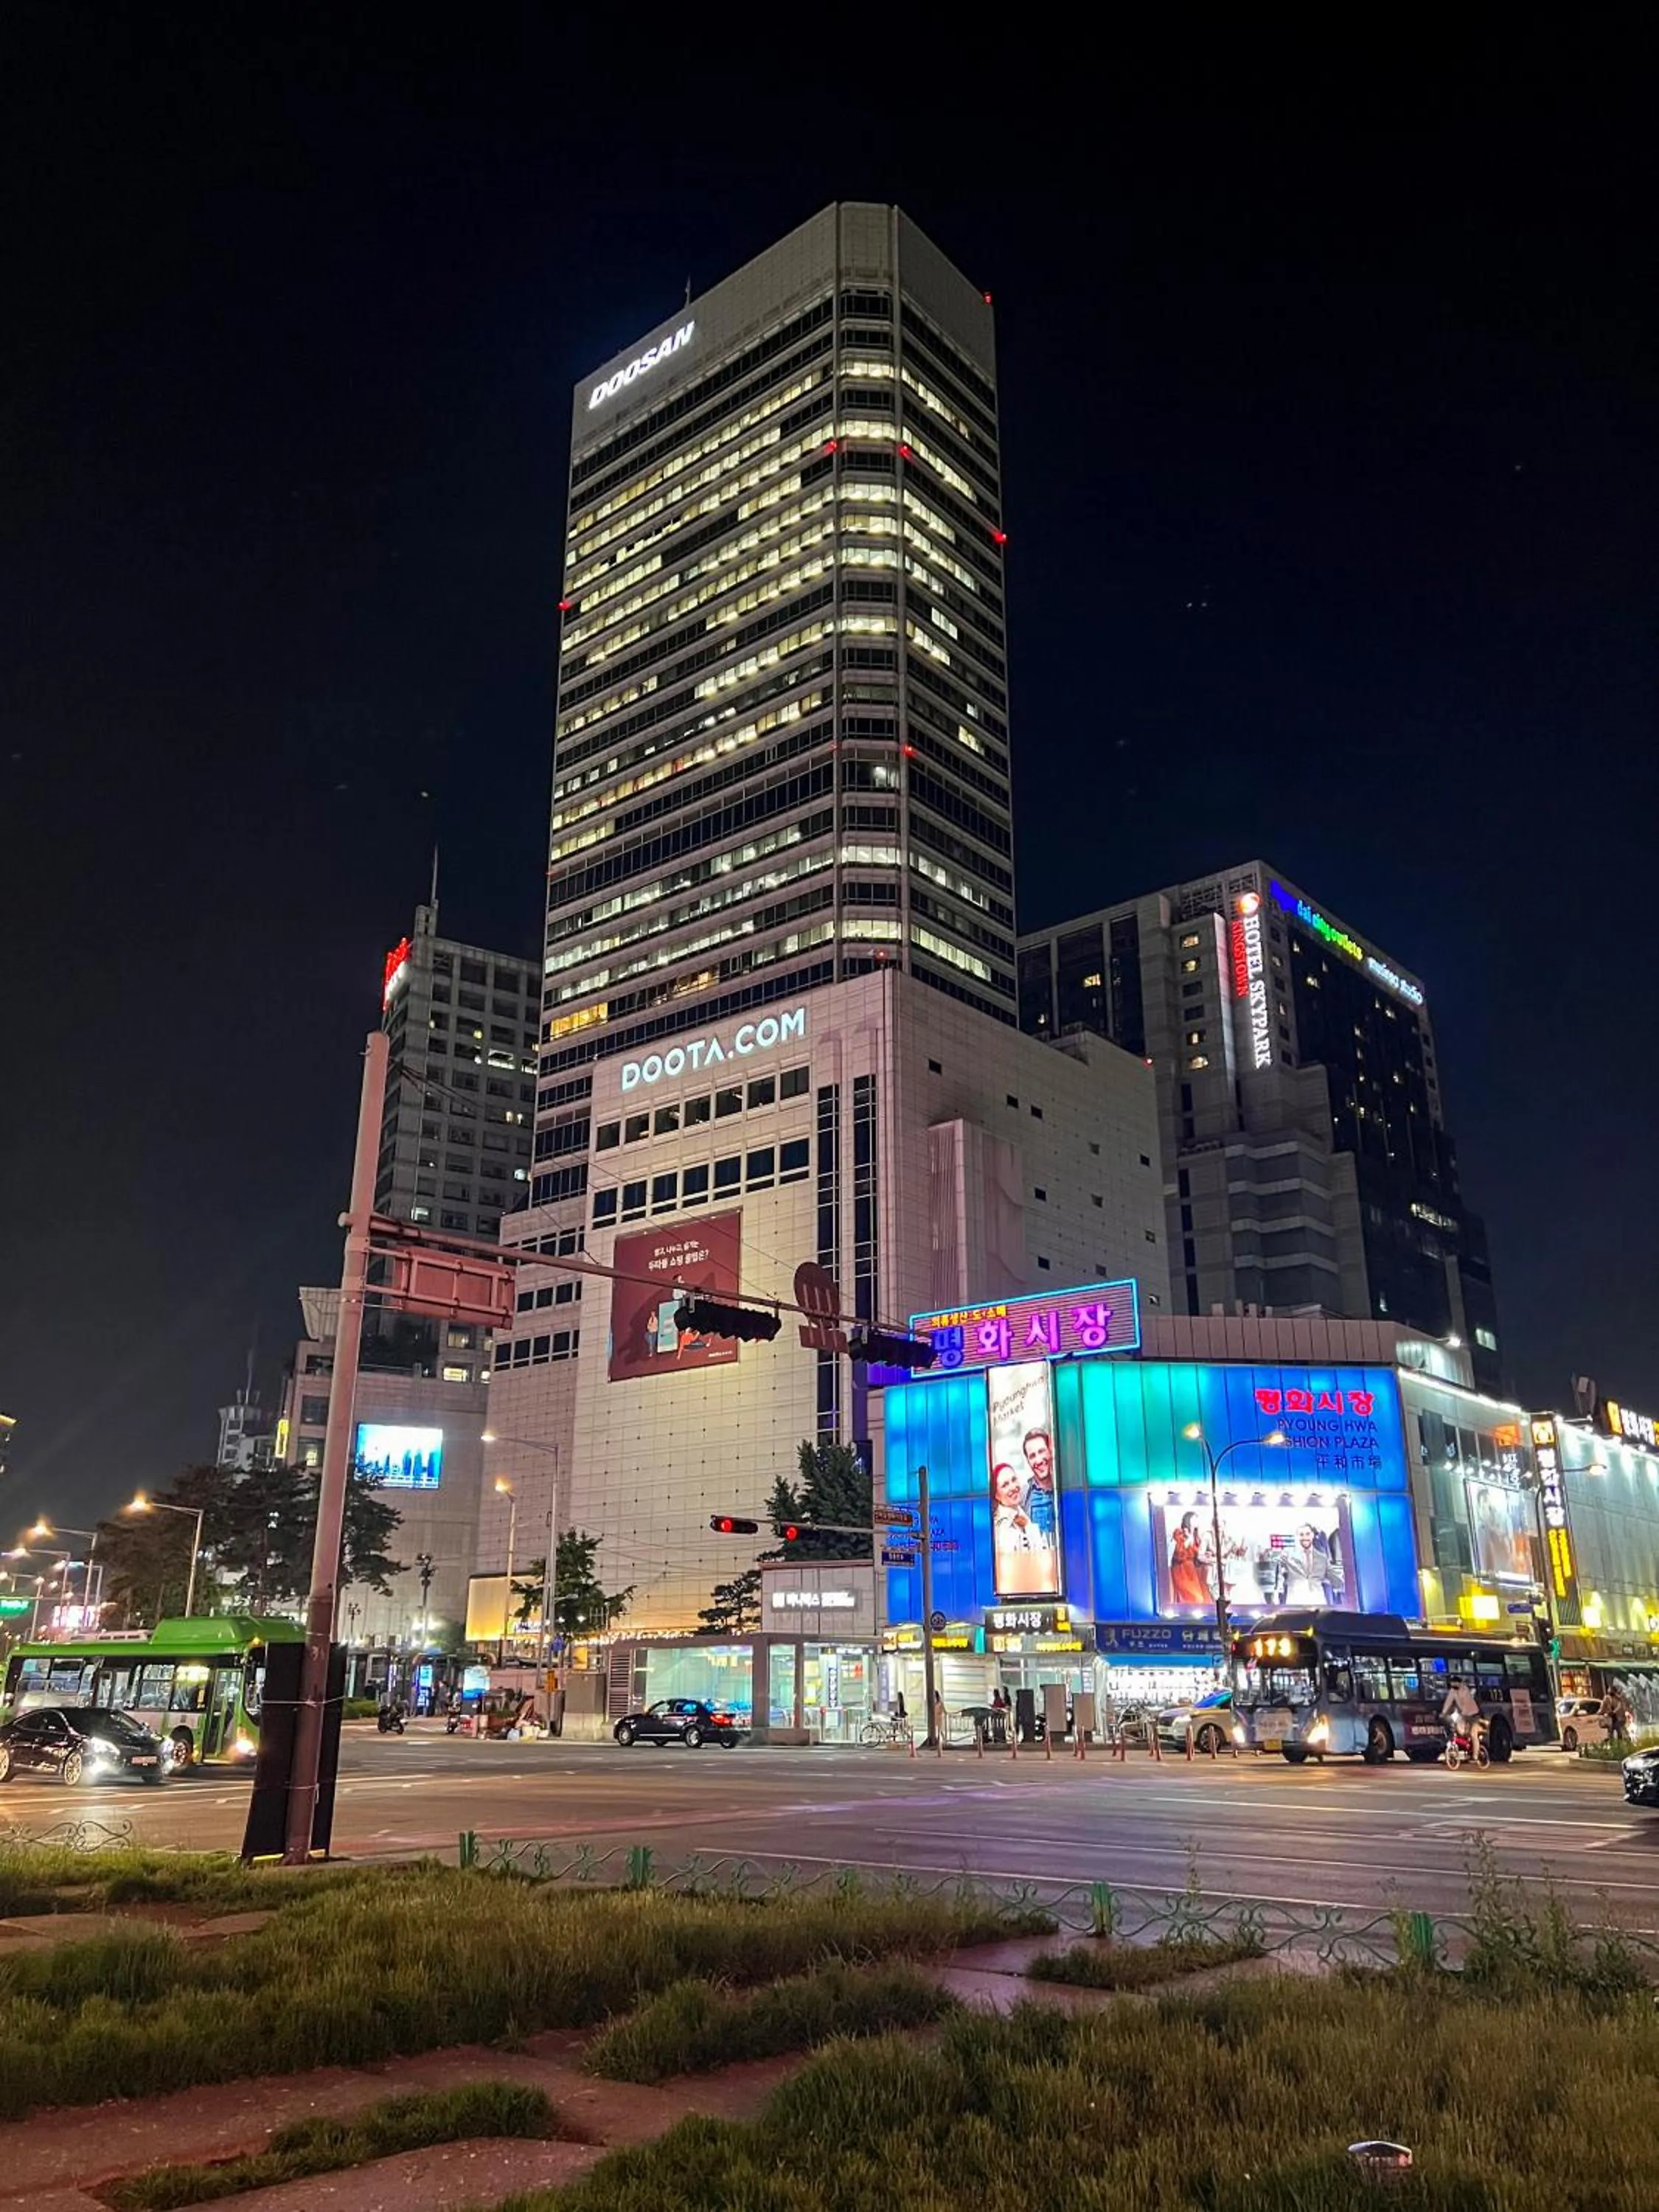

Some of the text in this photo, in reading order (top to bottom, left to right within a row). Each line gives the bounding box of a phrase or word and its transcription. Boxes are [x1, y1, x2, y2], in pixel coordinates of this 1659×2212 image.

[589, 320, 695, 409] DOOSAN
[1232, 920, 1248, 998] KINGSTOWN
[1244, 914, 1272, 1069] HOTEL SKYPARK
[621, 1007, 806, 1091] DOOTA.COM
[931, 1302, 1113, 1369] 평화시장
[1255, 1389, 1374, 1416] 평화시장
[1277, 1417, 1378, 1433] PYOUNG HWA
[1334, 1437, 1380, 1450] PLAZA
[993, 1612, 1042, 1629] 평화시장
[1121, 1628, 1172, 1640] FUZZO
